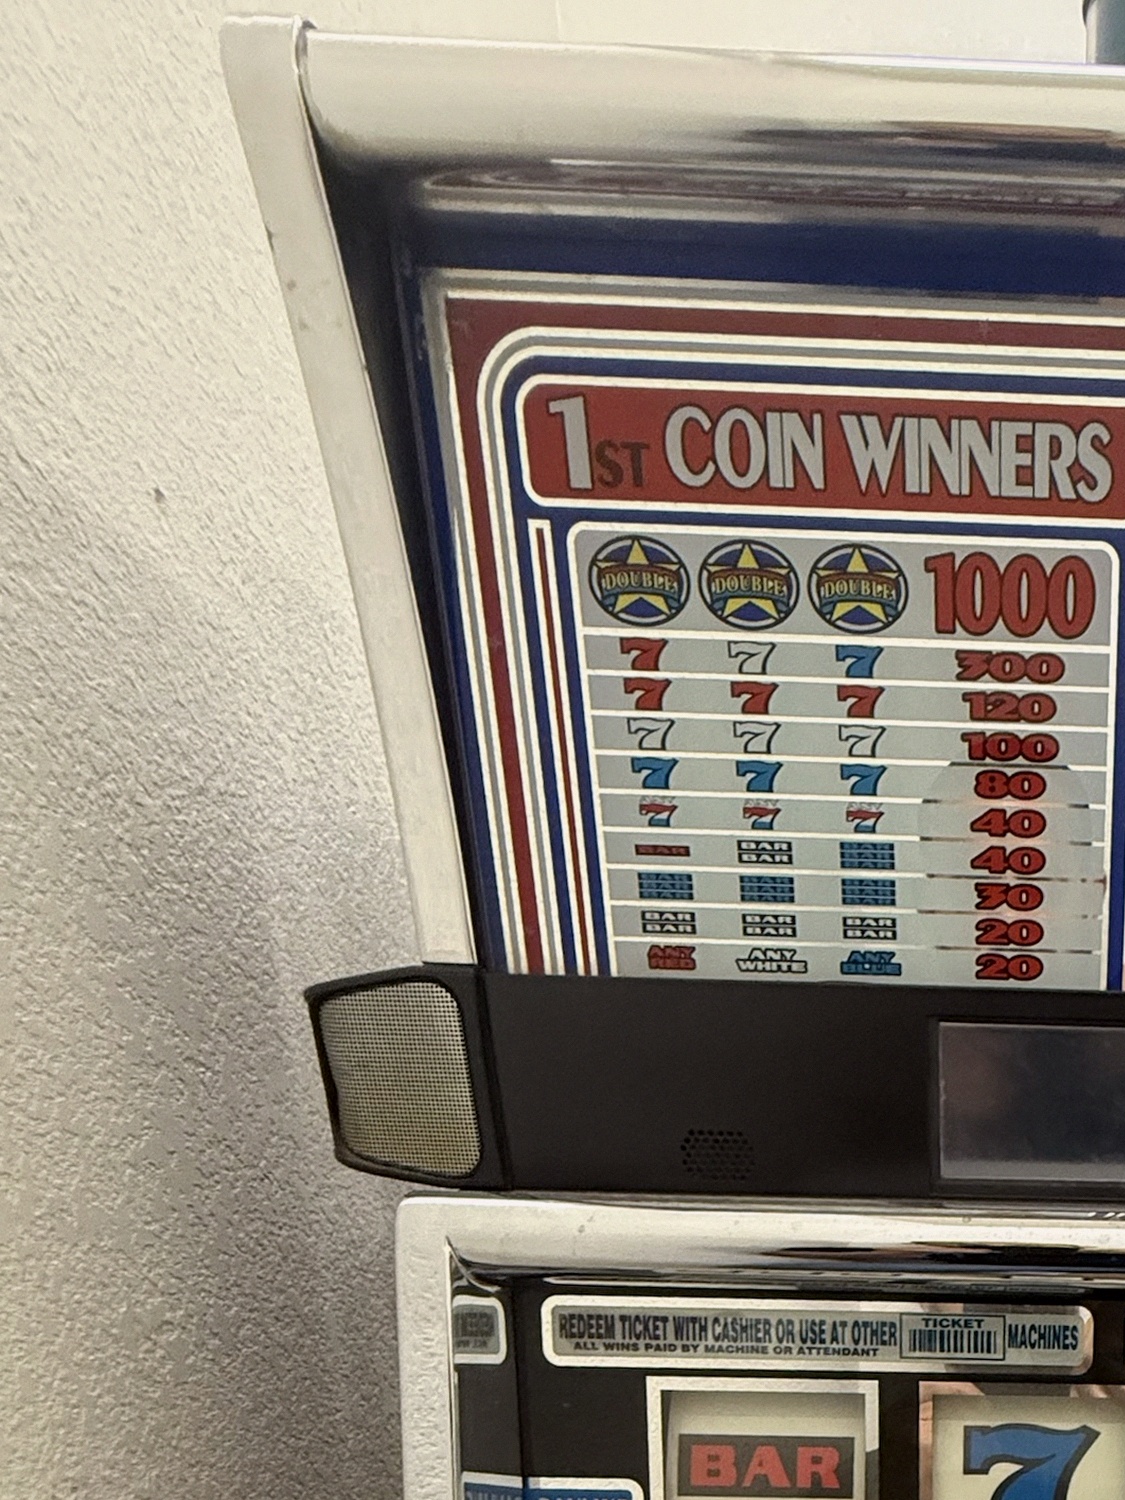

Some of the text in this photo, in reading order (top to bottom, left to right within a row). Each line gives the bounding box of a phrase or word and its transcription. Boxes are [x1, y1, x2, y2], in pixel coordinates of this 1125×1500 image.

[547, 395, 1114, 503] 1ST COIN WINNERS
[602, 569, 676, 593] DOUBLE
[710, 573, 785, 597] DOUBLE
[820, 577, 894, 601] DOUBLE
[924, 551, 1097, 638] 1000
[955, 649, 1066, 684] 300
[961, 691, 1057, 724] 120
[960, 731, 1060, 763] 100
[974, 769, 1047, 800] 80
[969, 808, 1047, 838] 40
[970, 845, 1047, 875] 40
[974, 883, 1044, 911] 30
[975, 918, 1044, 946] 20
[737, 959, 807, 975] WHITE
[748, 947, 796, 961] ANY
[975, 953, 1044, 981] 20
[558, 1313, 898, 1347] REDEEM TICKET WITH CASHIER OR USE AT OTHER
[921, 1317, 985, 1330] TICKET
[1007, 1323, 1079, 1350] MACHINES
[573, 1341, 879, 1358] ALL WINS PAID BY MACHINE OR ATTENDANT
[689, 1443, 842, 1490] BAR
